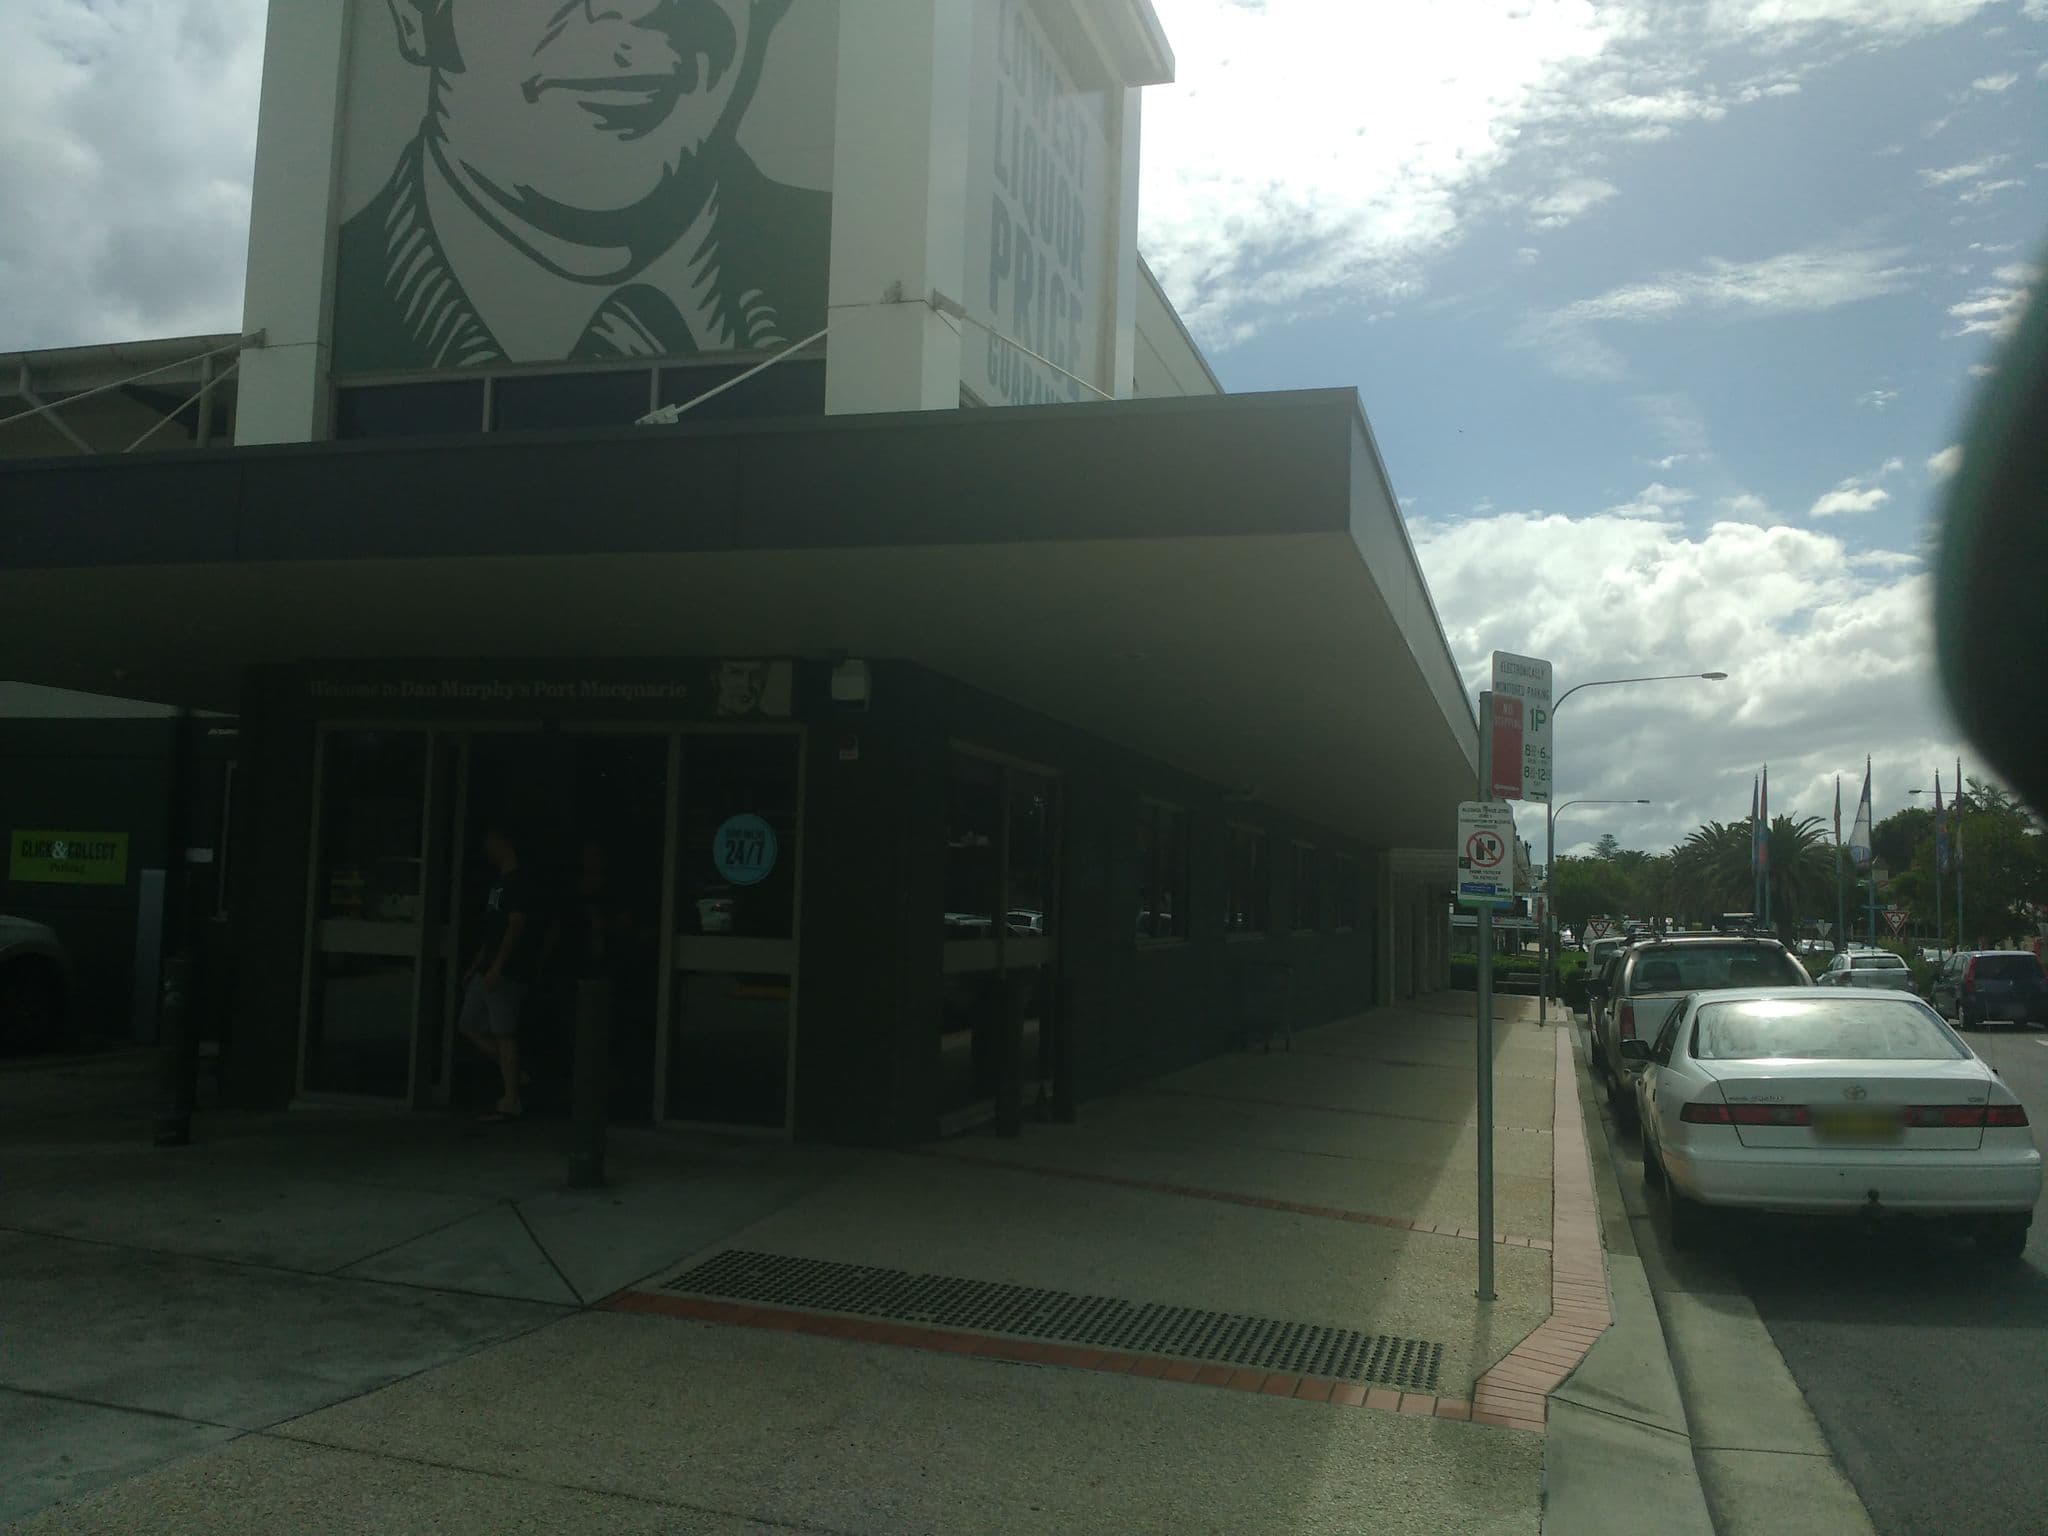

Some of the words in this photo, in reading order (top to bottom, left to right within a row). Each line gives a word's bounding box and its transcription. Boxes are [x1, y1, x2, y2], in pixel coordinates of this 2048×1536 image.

[993, 78, 1085, 292] LIQUOR
[989, 190, 1084, 402] PRICE
[400, 681, 438, 698] Dan
[441, 680, 530, 703] Murphy's
[533, 681, 576, 698] Port
[579, 680, 688, 703] Macquarie
[725, 839, 765, 865] 24/7
